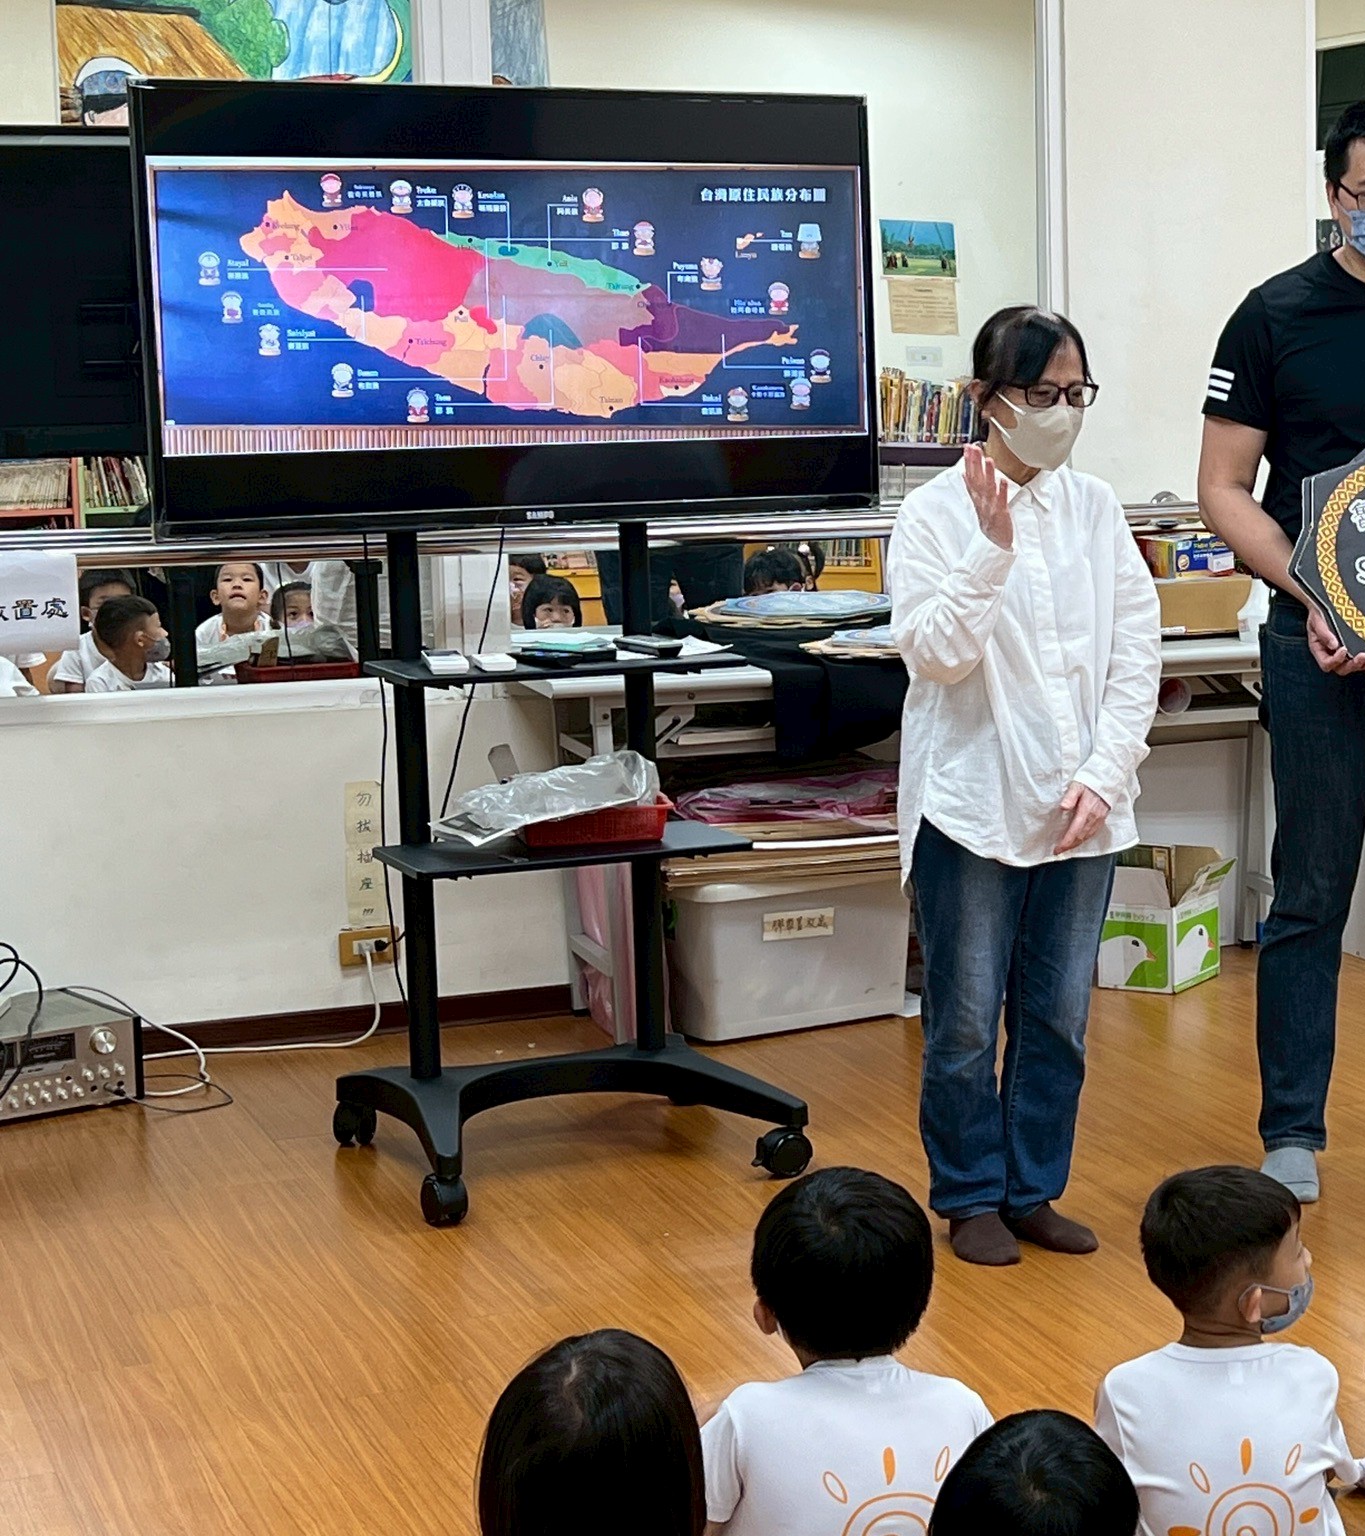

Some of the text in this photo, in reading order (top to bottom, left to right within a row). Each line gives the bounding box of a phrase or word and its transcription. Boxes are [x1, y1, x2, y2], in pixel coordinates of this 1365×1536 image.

[701, 187, 827, 202] 台灣原住民族分布圖
